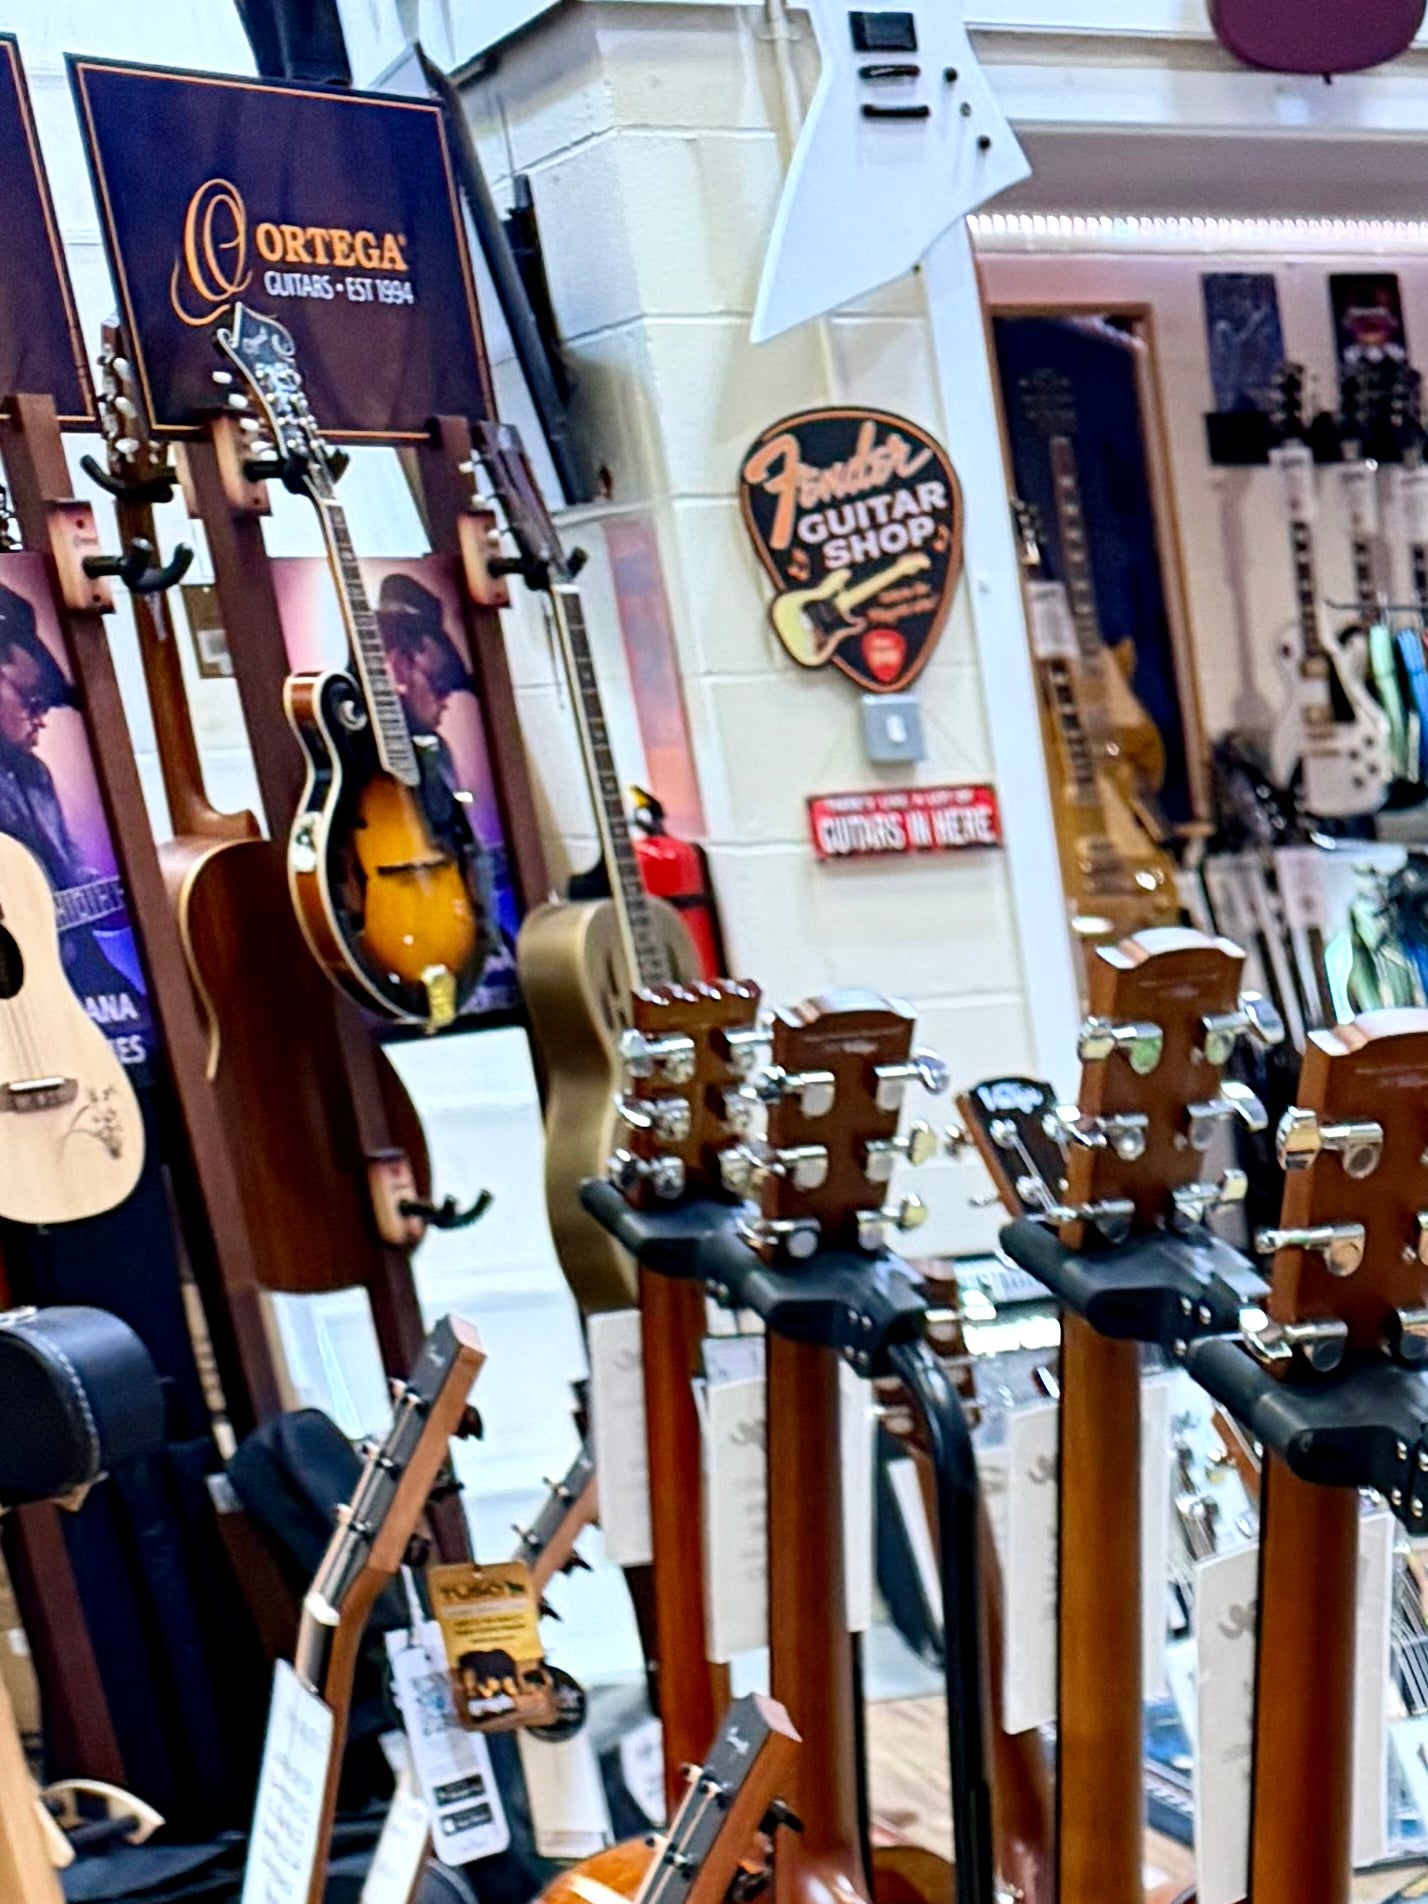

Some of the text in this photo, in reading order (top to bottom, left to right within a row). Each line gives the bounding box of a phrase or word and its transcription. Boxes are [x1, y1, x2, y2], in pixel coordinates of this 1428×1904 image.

[256, 222, 409, 271] ORTEGA
[264, 270, 334, 299] GUITARS
[345, 277, 375, 303] EST
[744, 420, 933, 550] Fender
[797, 480, 947, 545] GUITAR
[822, 515, 936, 570] SHOP
